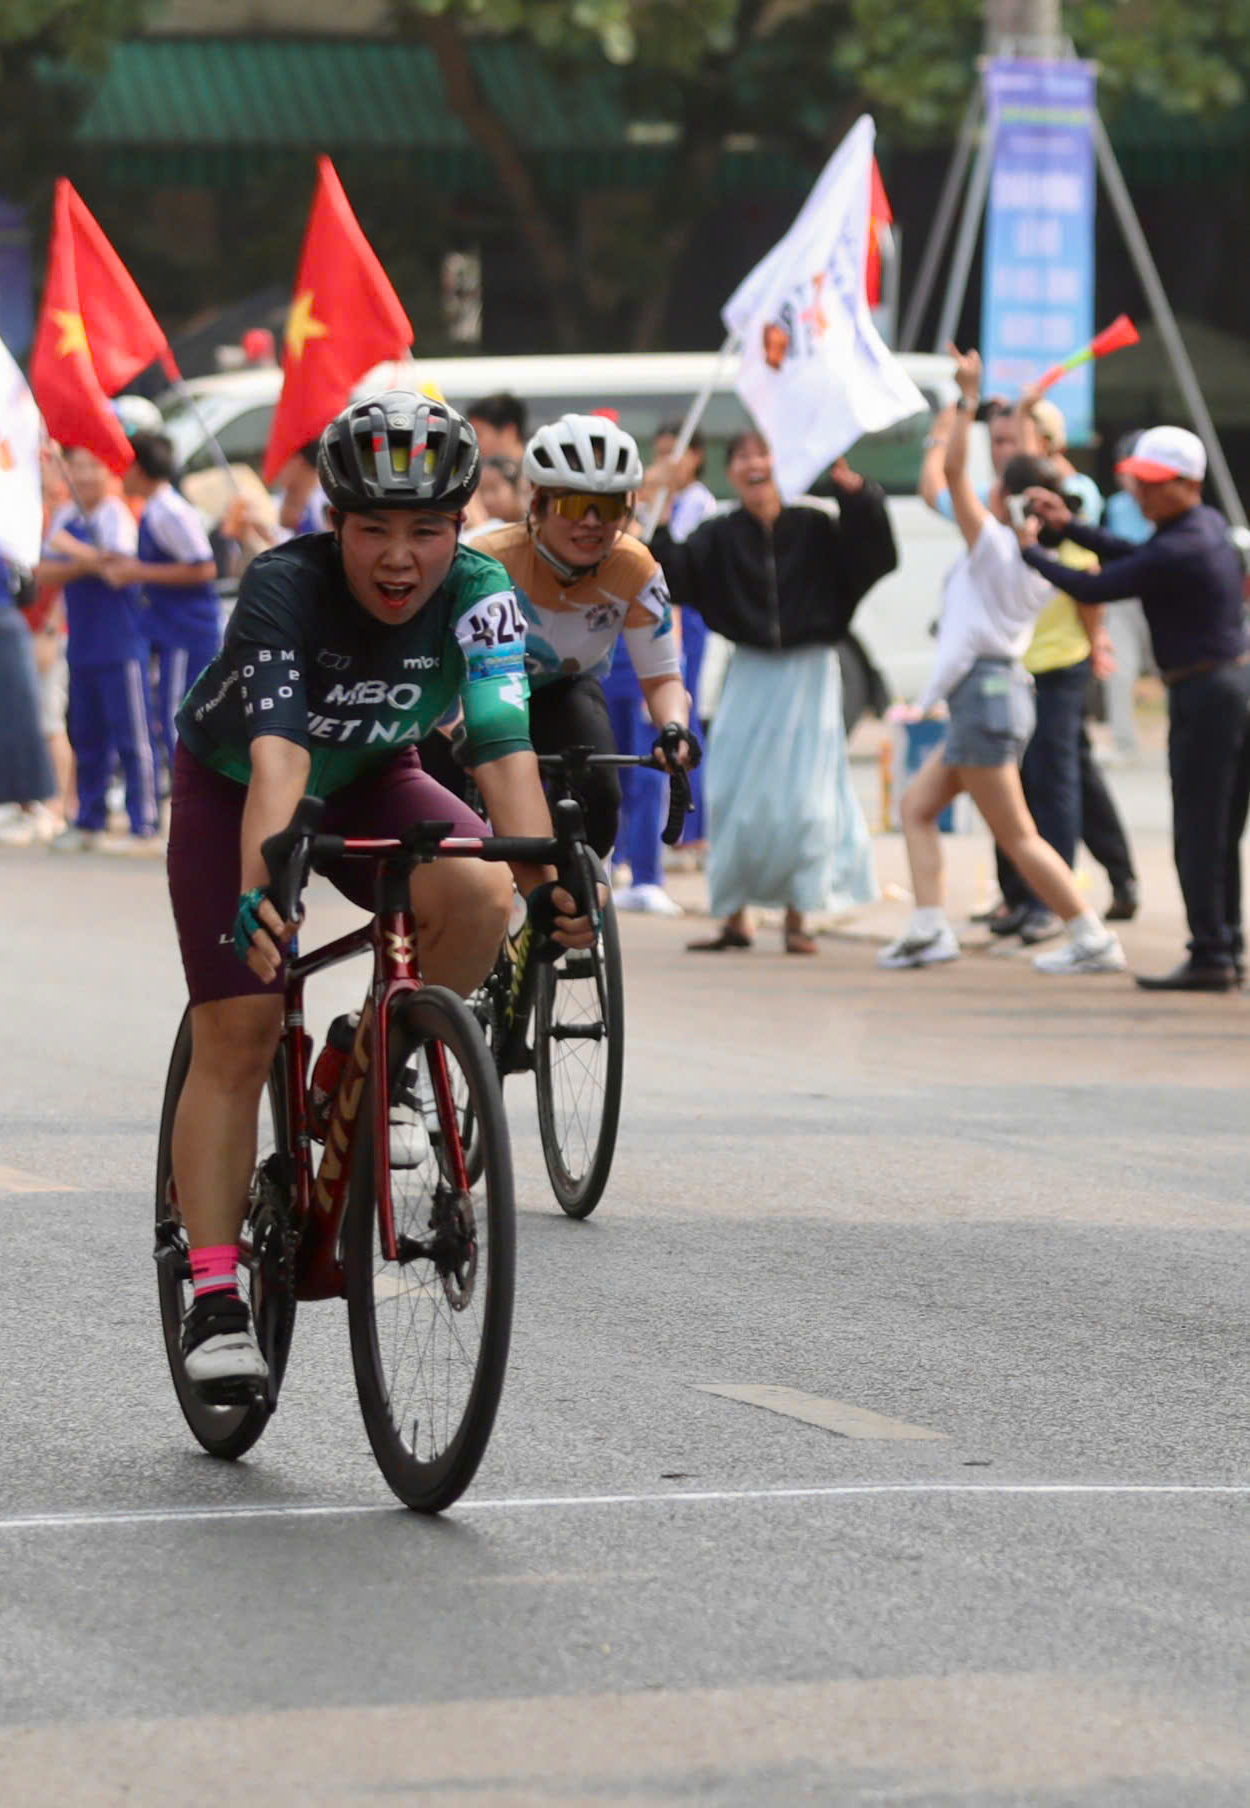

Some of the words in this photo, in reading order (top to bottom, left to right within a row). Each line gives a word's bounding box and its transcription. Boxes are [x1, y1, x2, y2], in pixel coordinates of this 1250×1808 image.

[468, 599, 525, 649] 424
[324, 680, 422, 710] MBO
[307, 711, 362, 742] IET
[366, 720, 424, 745] NA
